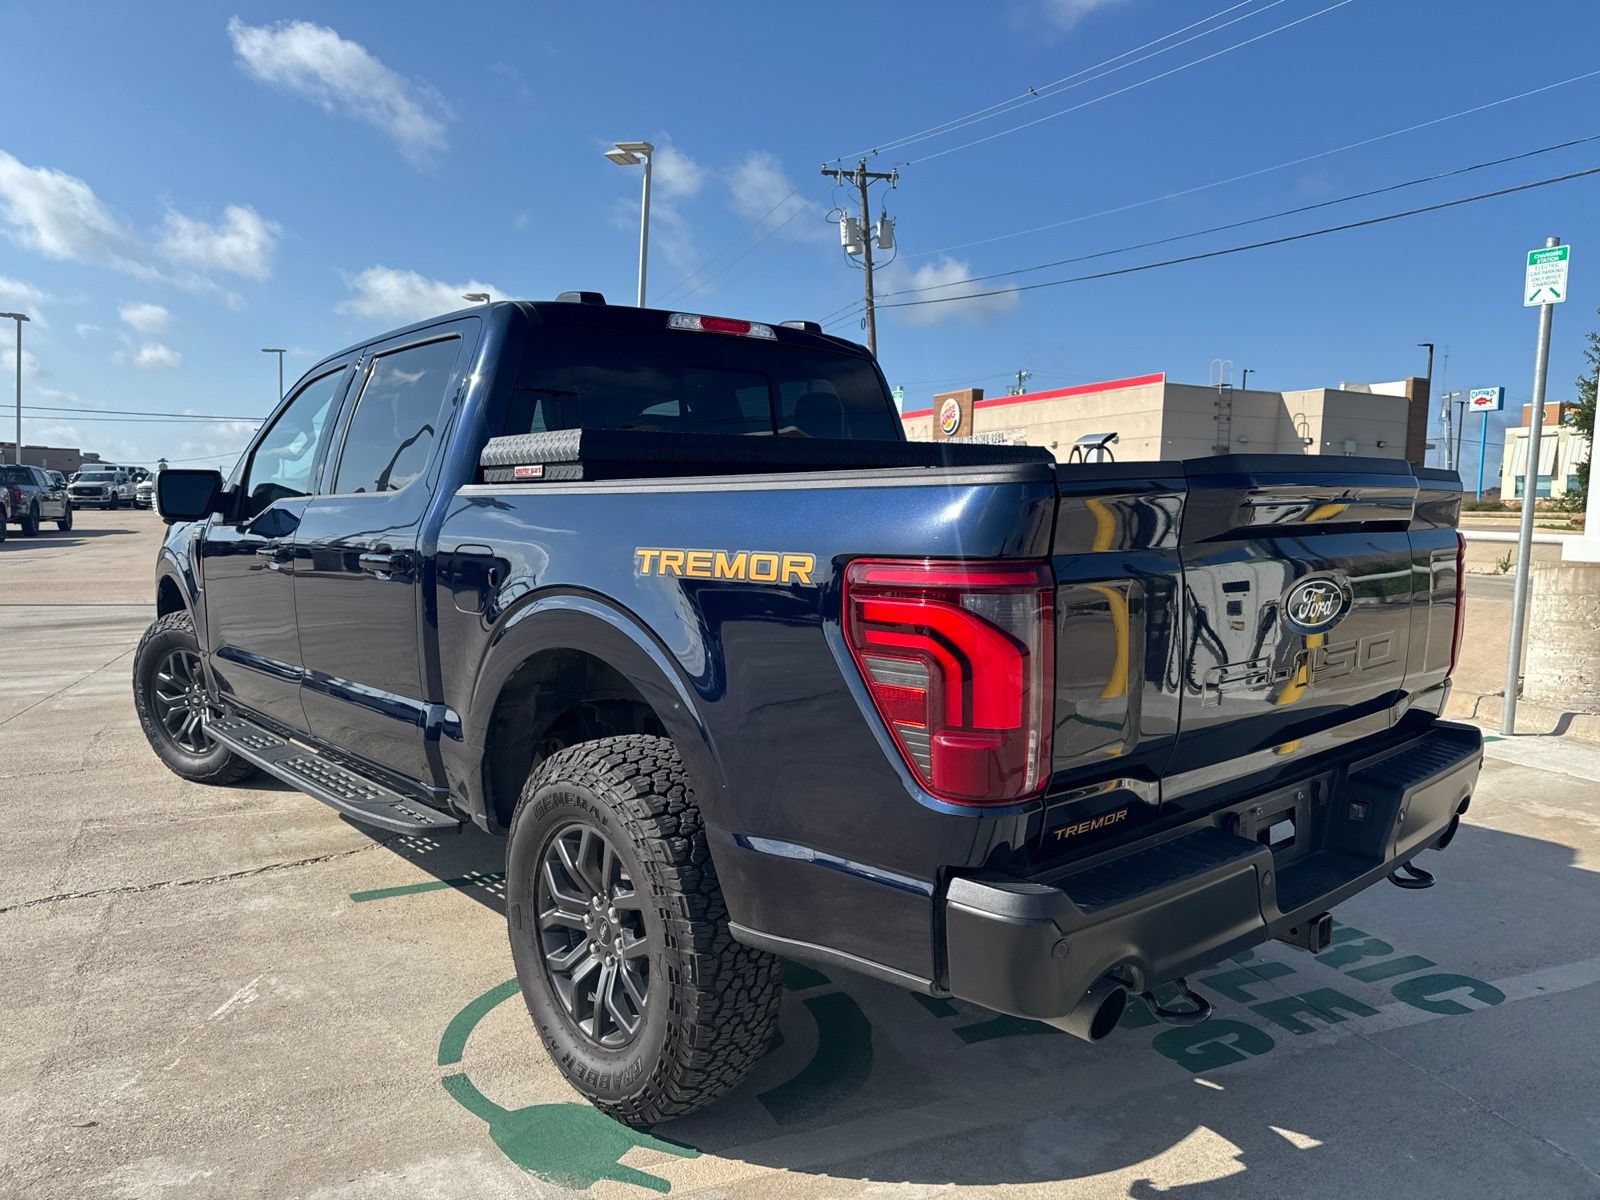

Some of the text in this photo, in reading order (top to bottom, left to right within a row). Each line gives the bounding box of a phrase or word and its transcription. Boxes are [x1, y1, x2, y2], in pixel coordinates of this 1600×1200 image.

[635, 547, 816, 587] TREMOR
[1299, 587, 1338, 619] Ford
[533, 791, 609, 826] GENERAL
[1055, 808, 1128, 840] TREMOR
[562, 1051, 643, 1091] GRABBER
